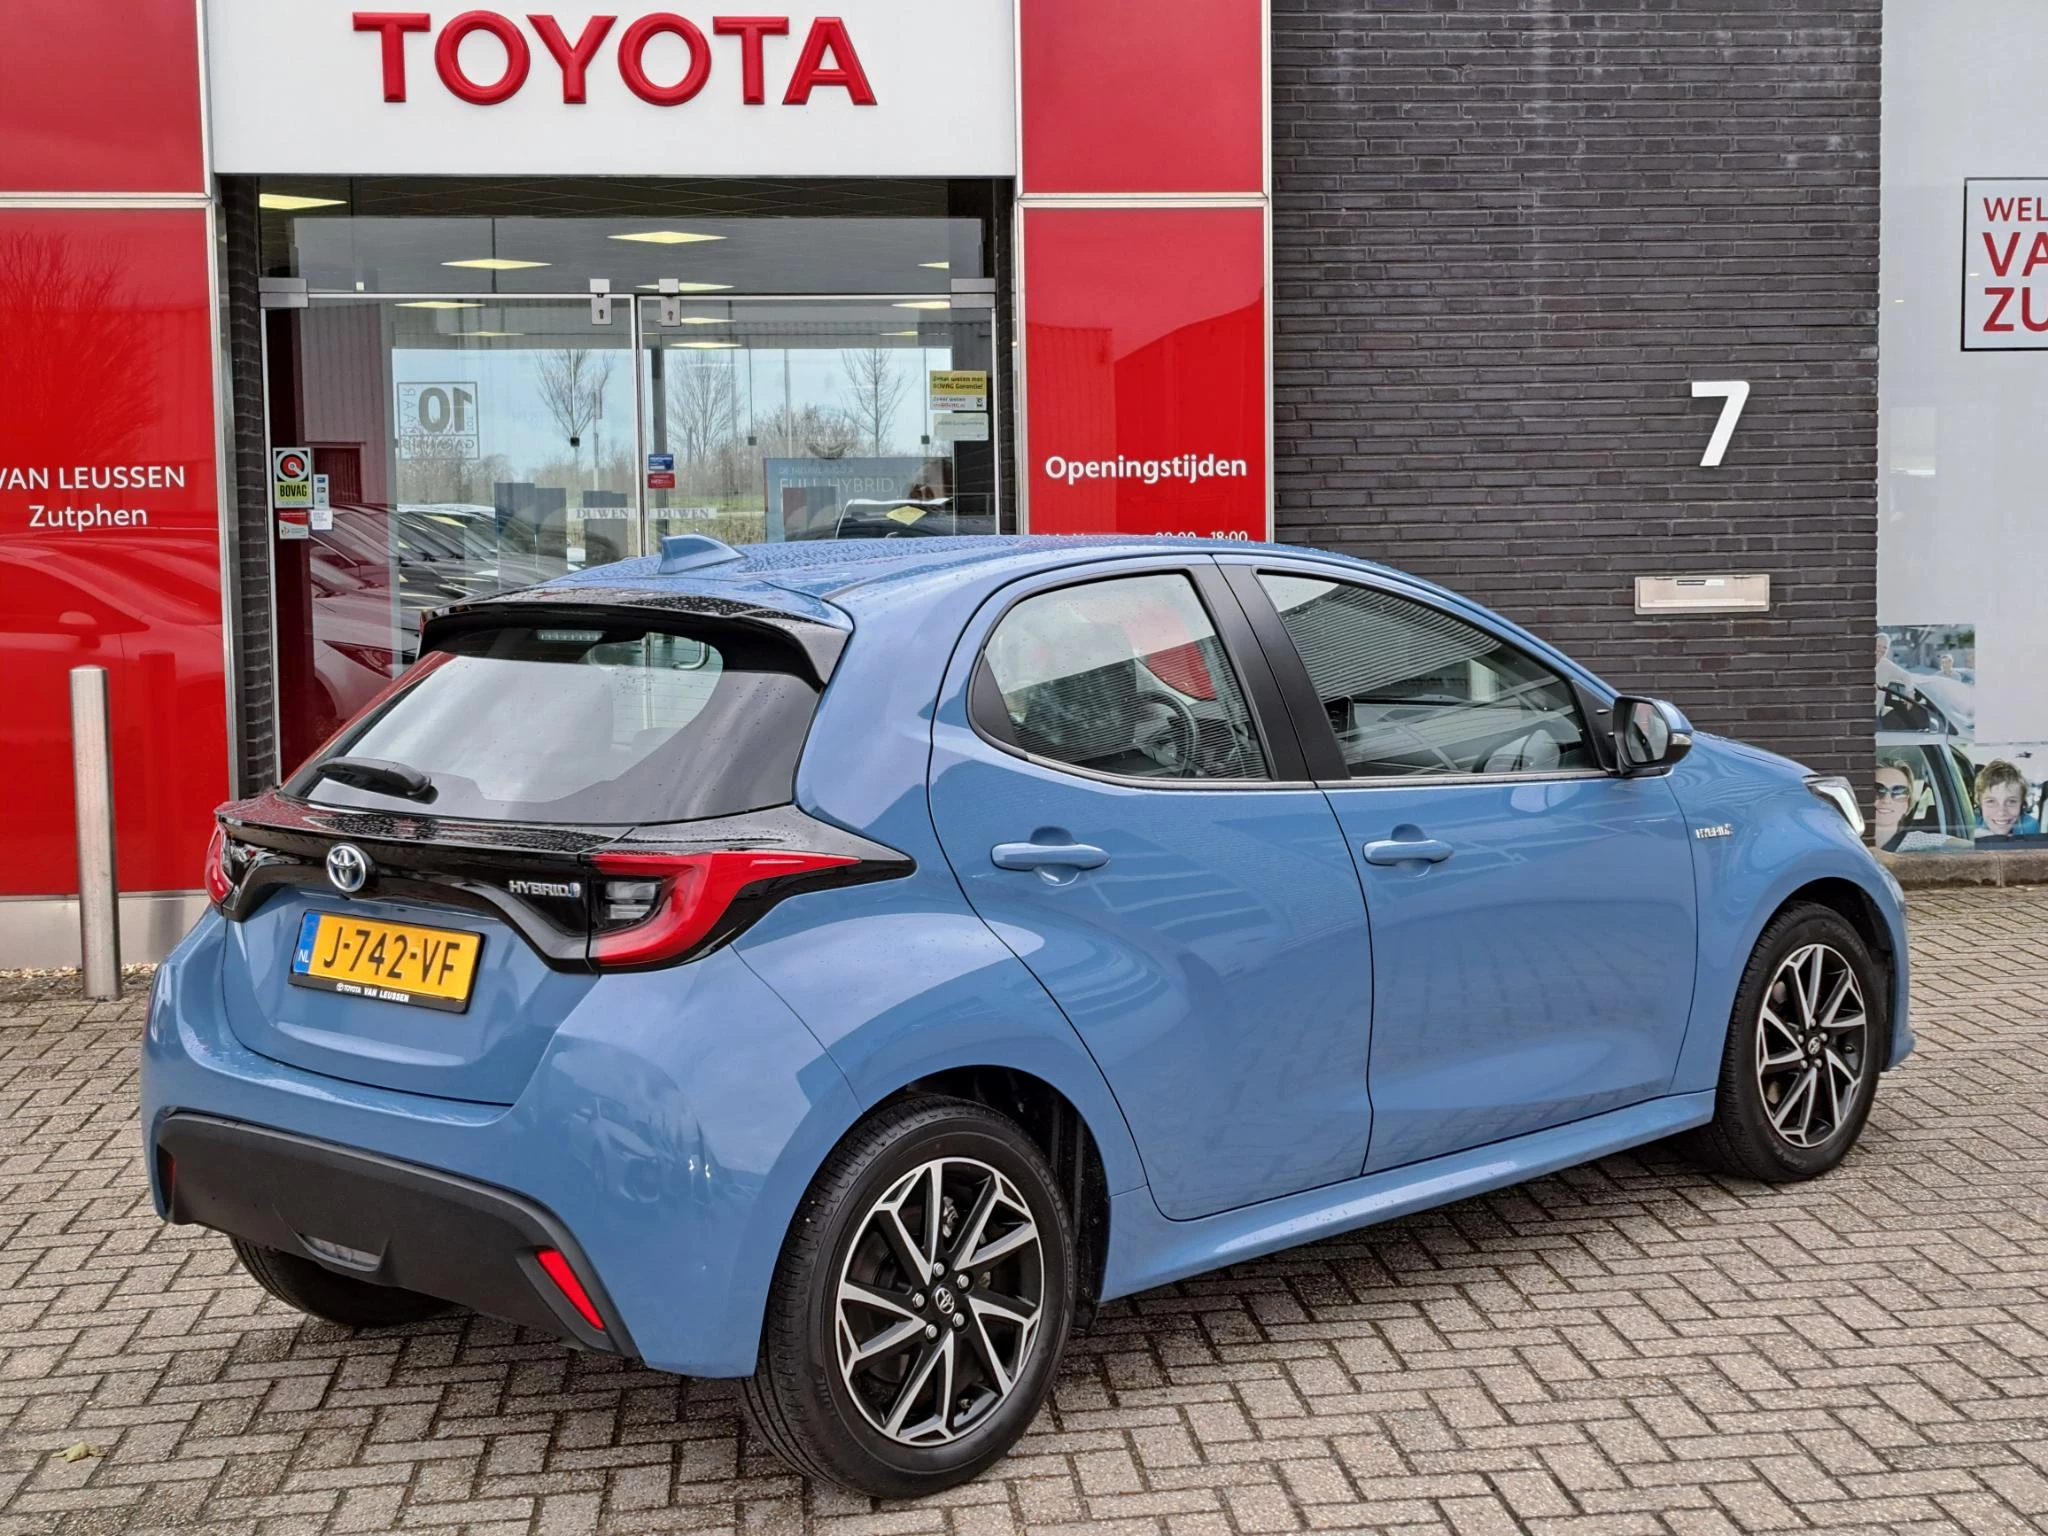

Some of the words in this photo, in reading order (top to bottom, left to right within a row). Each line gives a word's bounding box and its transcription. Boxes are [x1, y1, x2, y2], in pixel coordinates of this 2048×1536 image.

[352, 9, 878, 106] TOYOTA
[1983, 197, 2048, 222] WEL
[1982, 232, 2048, 277] VA
[1983, 287, 2048, 332] ZU
[1691, 381, 1750, 467] 7
[59, 466, 185, 489] LEUSSEN
[1045, 453, 1247, 485] Openingstijden
[280, 484, 307, 497] BOVAG
[828, 478, 895, 493] HYBRID
[29, 504, 147, 532] Zutphen
[576, 508, 629, 519] DUWEN
[657, 508, 709, 519] DUWEN
[509, 880, 569, 896] HYBRID
[298, 950, 309, 963] NL
[323, 926, 460, 986] J-742-VF
[364, 987, 377, 997] VAN
[379, 990, 410, 1002] LEUSSEN
